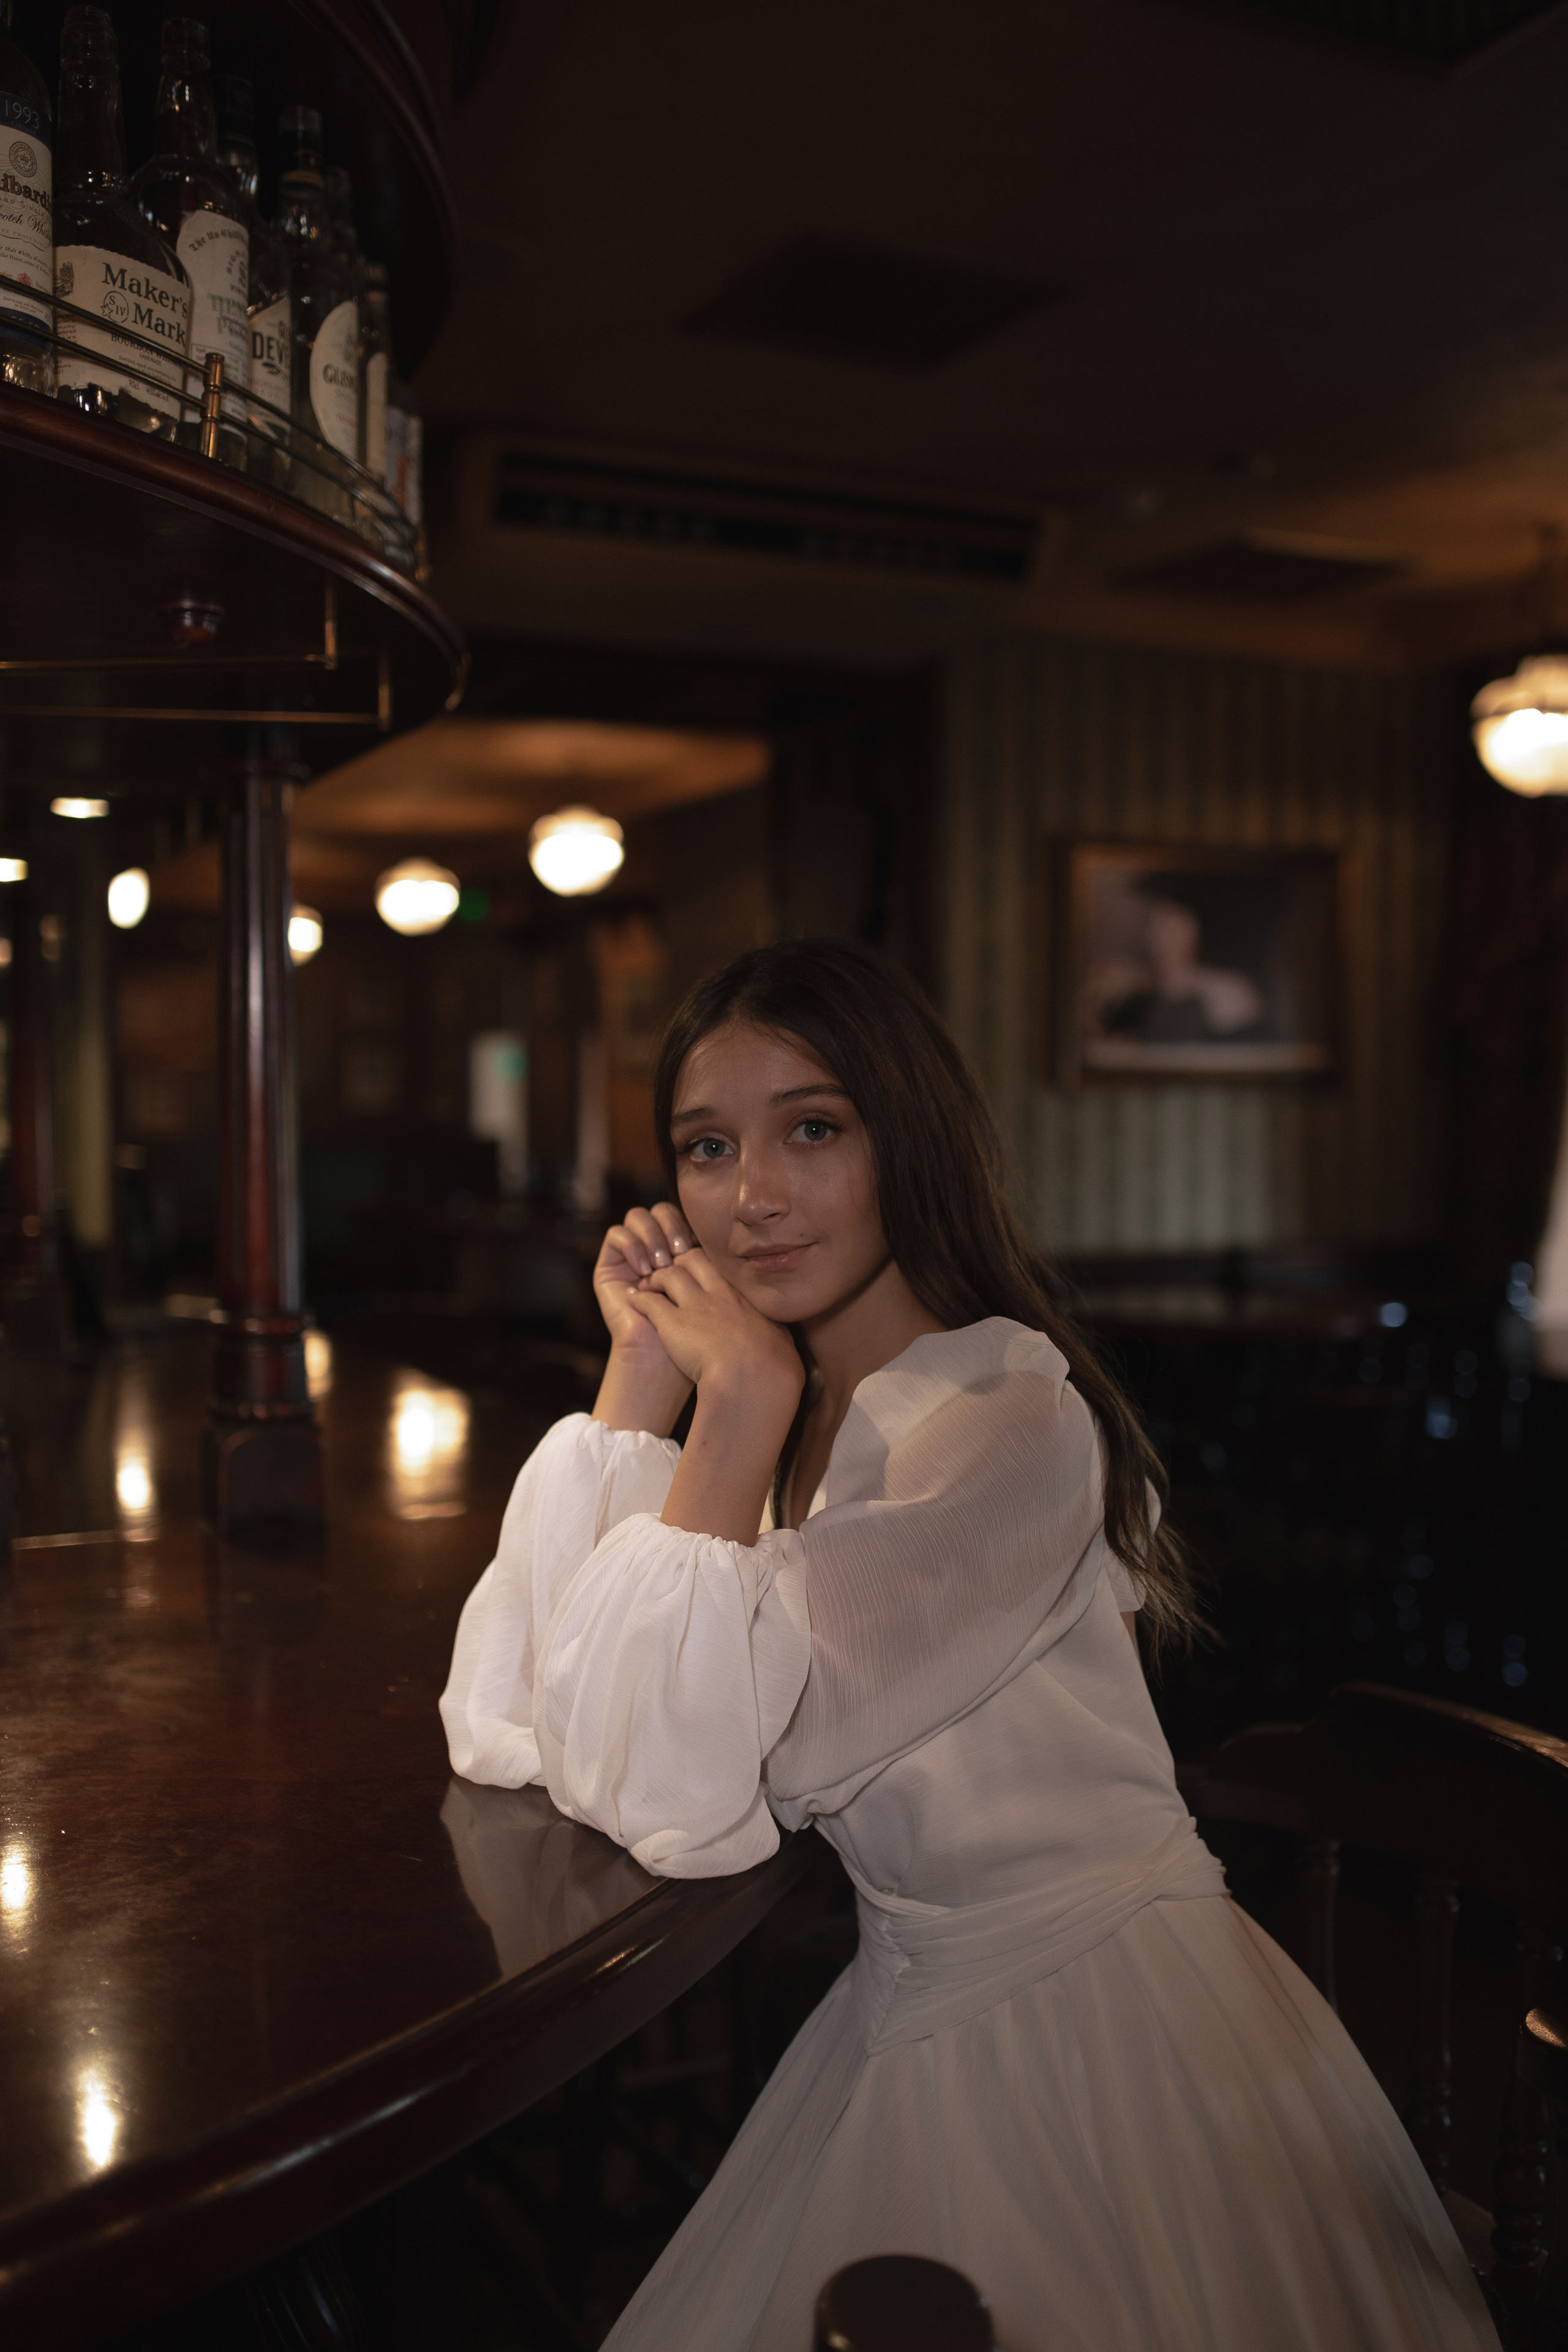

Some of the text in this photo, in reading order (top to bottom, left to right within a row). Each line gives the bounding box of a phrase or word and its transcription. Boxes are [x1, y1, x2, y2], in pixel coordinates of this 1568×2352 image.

[5, 99, 39, 130] 1993
[0, 173, 52, 216] ibardi
[0, 212, 24, 227] cotch
[102, 262, 187, 319] Maker's
[109, 295, 116, 306] S
[115, 305, 126, 317] IV
[132, 302, 186, 348] Mark
